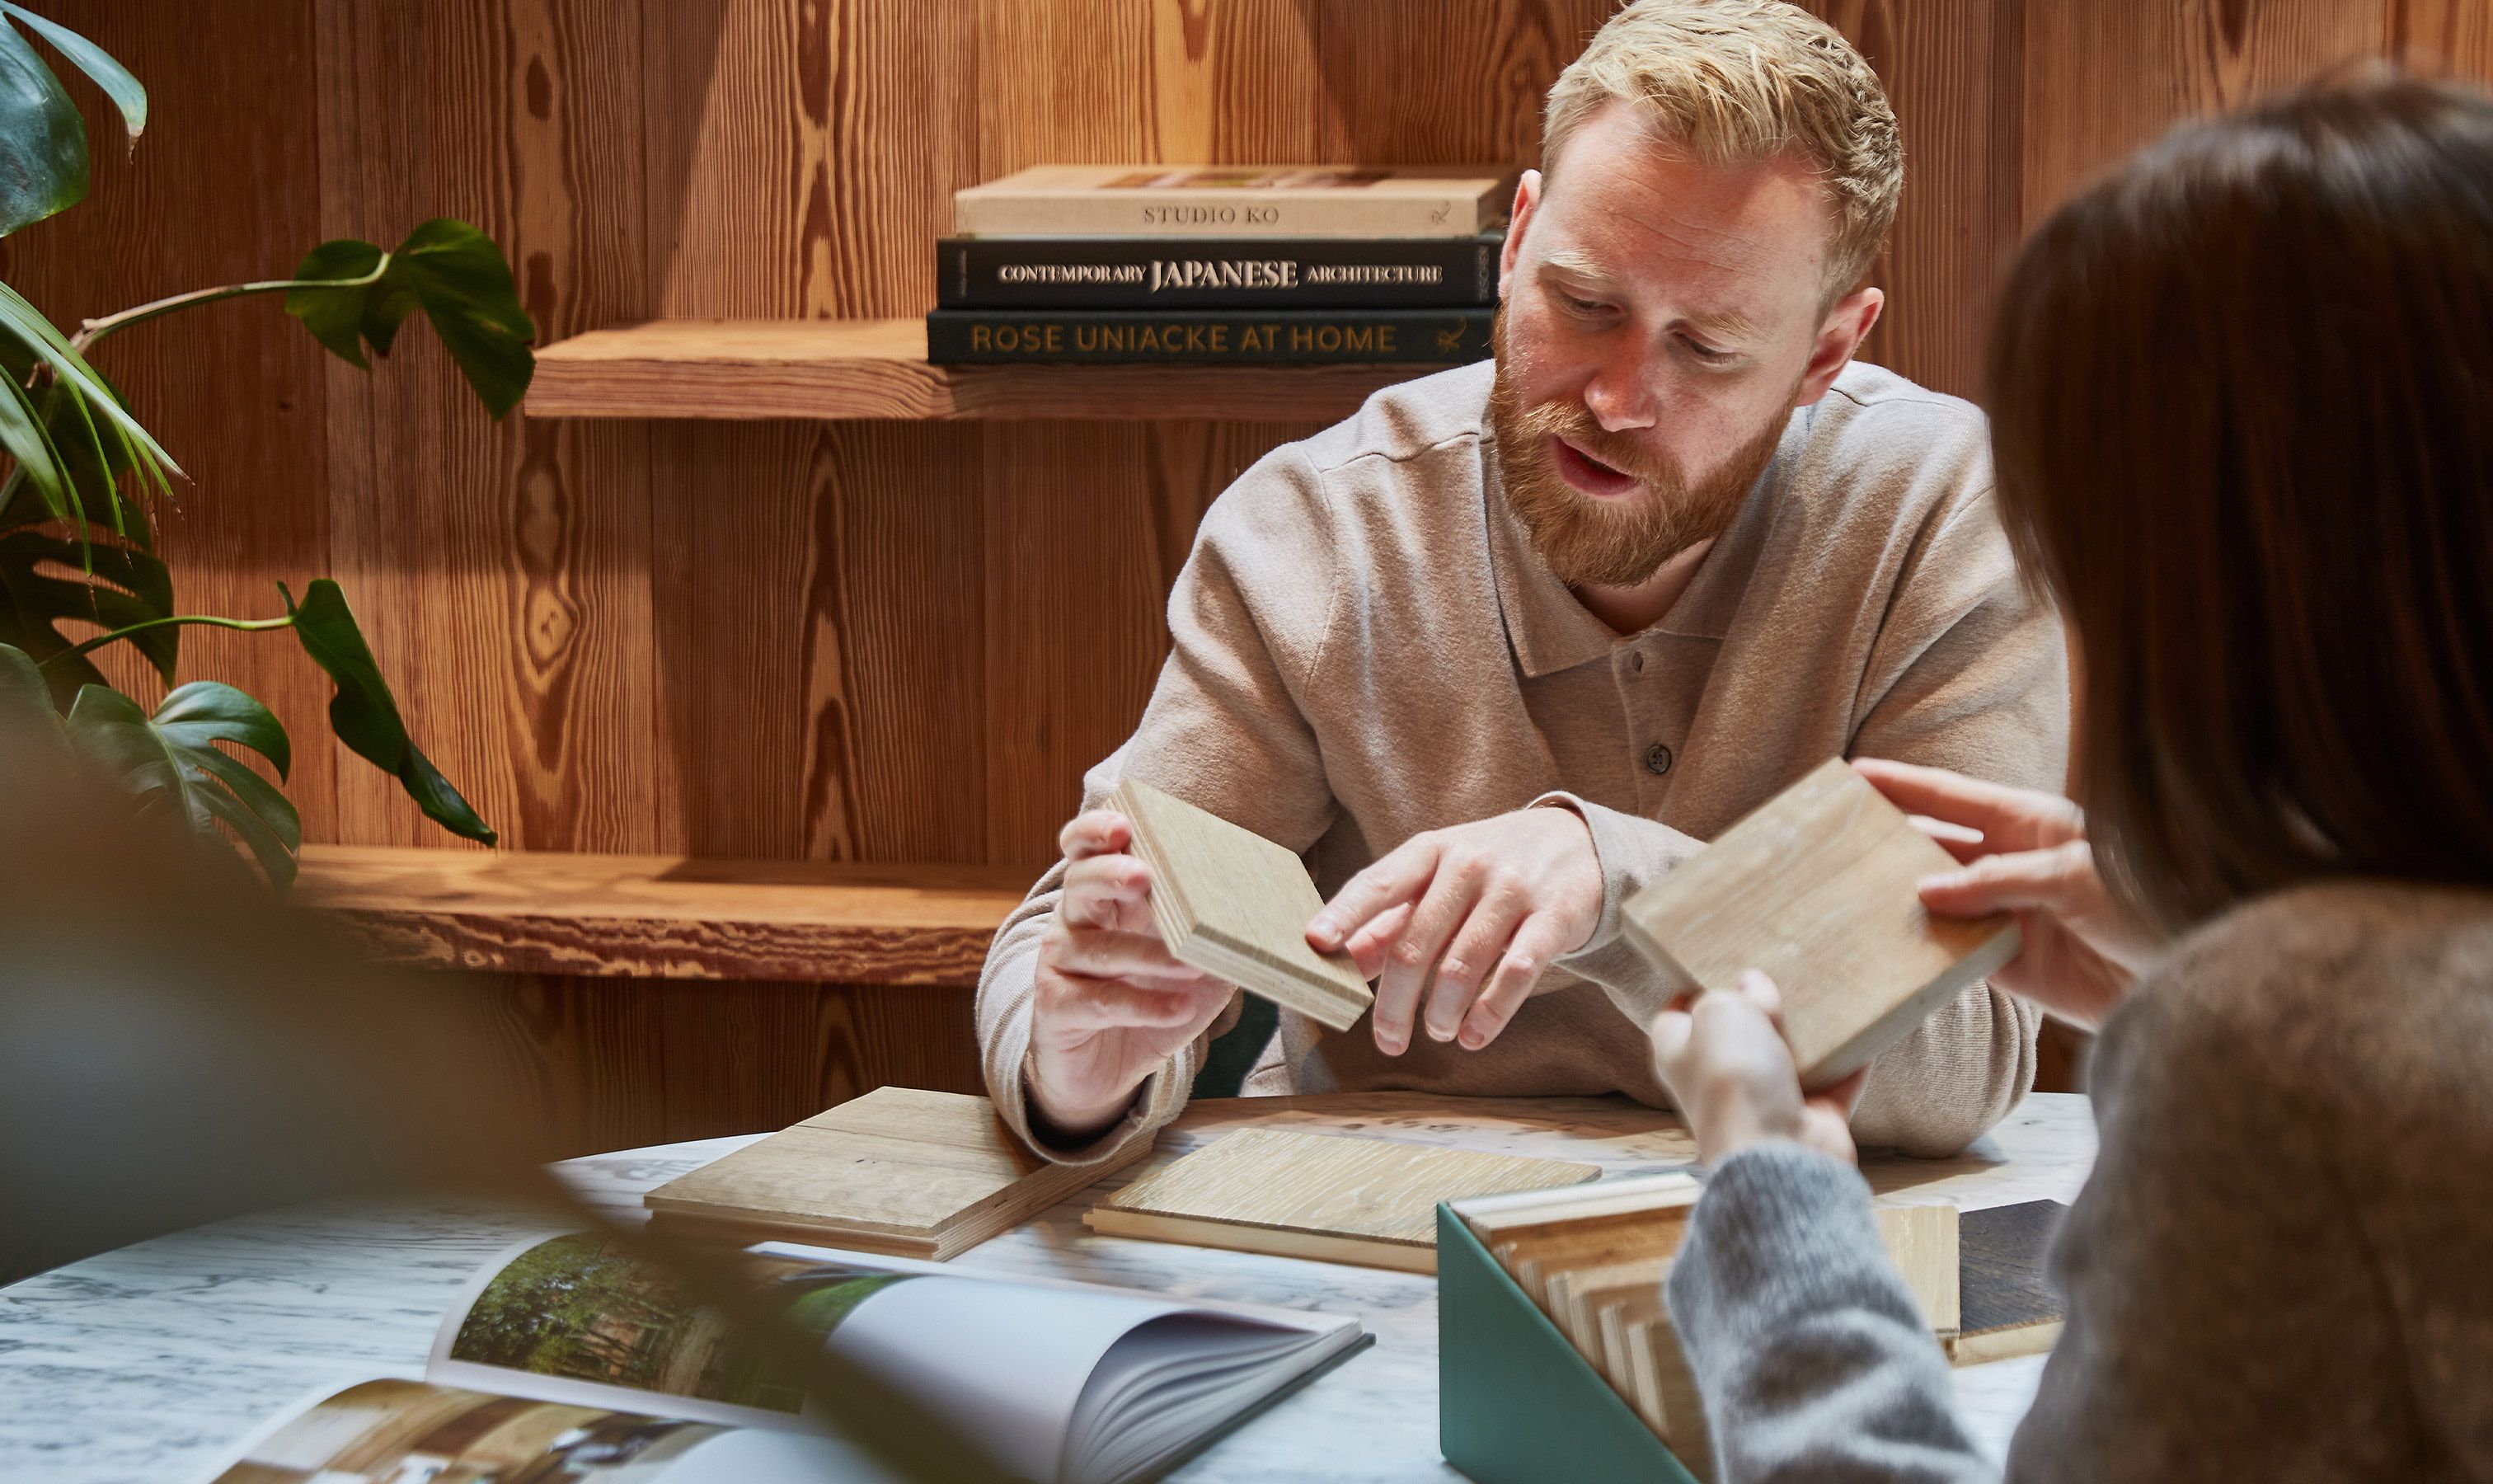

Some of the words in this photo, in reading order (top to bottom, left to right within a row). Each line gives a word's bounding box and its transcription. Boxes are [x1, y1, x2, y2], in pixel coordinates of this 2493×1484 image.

[1143, 205, 1236, 225] STUDIO
[1246, 205, 1279, 226] KO
[998, 263, 1147, 284] CONTEMPORARY
[1150, 260, 1298, 293] JAPANESE
[1306, 265, 1444, 285] ARCHITECTURE
[971, 324, 1063, 353] ROSE
[1076, 324, 1228, 353] UNIACKE
[1241, 324, 1281, 352] AT
[1291, 324, 1397, 353] HOME
